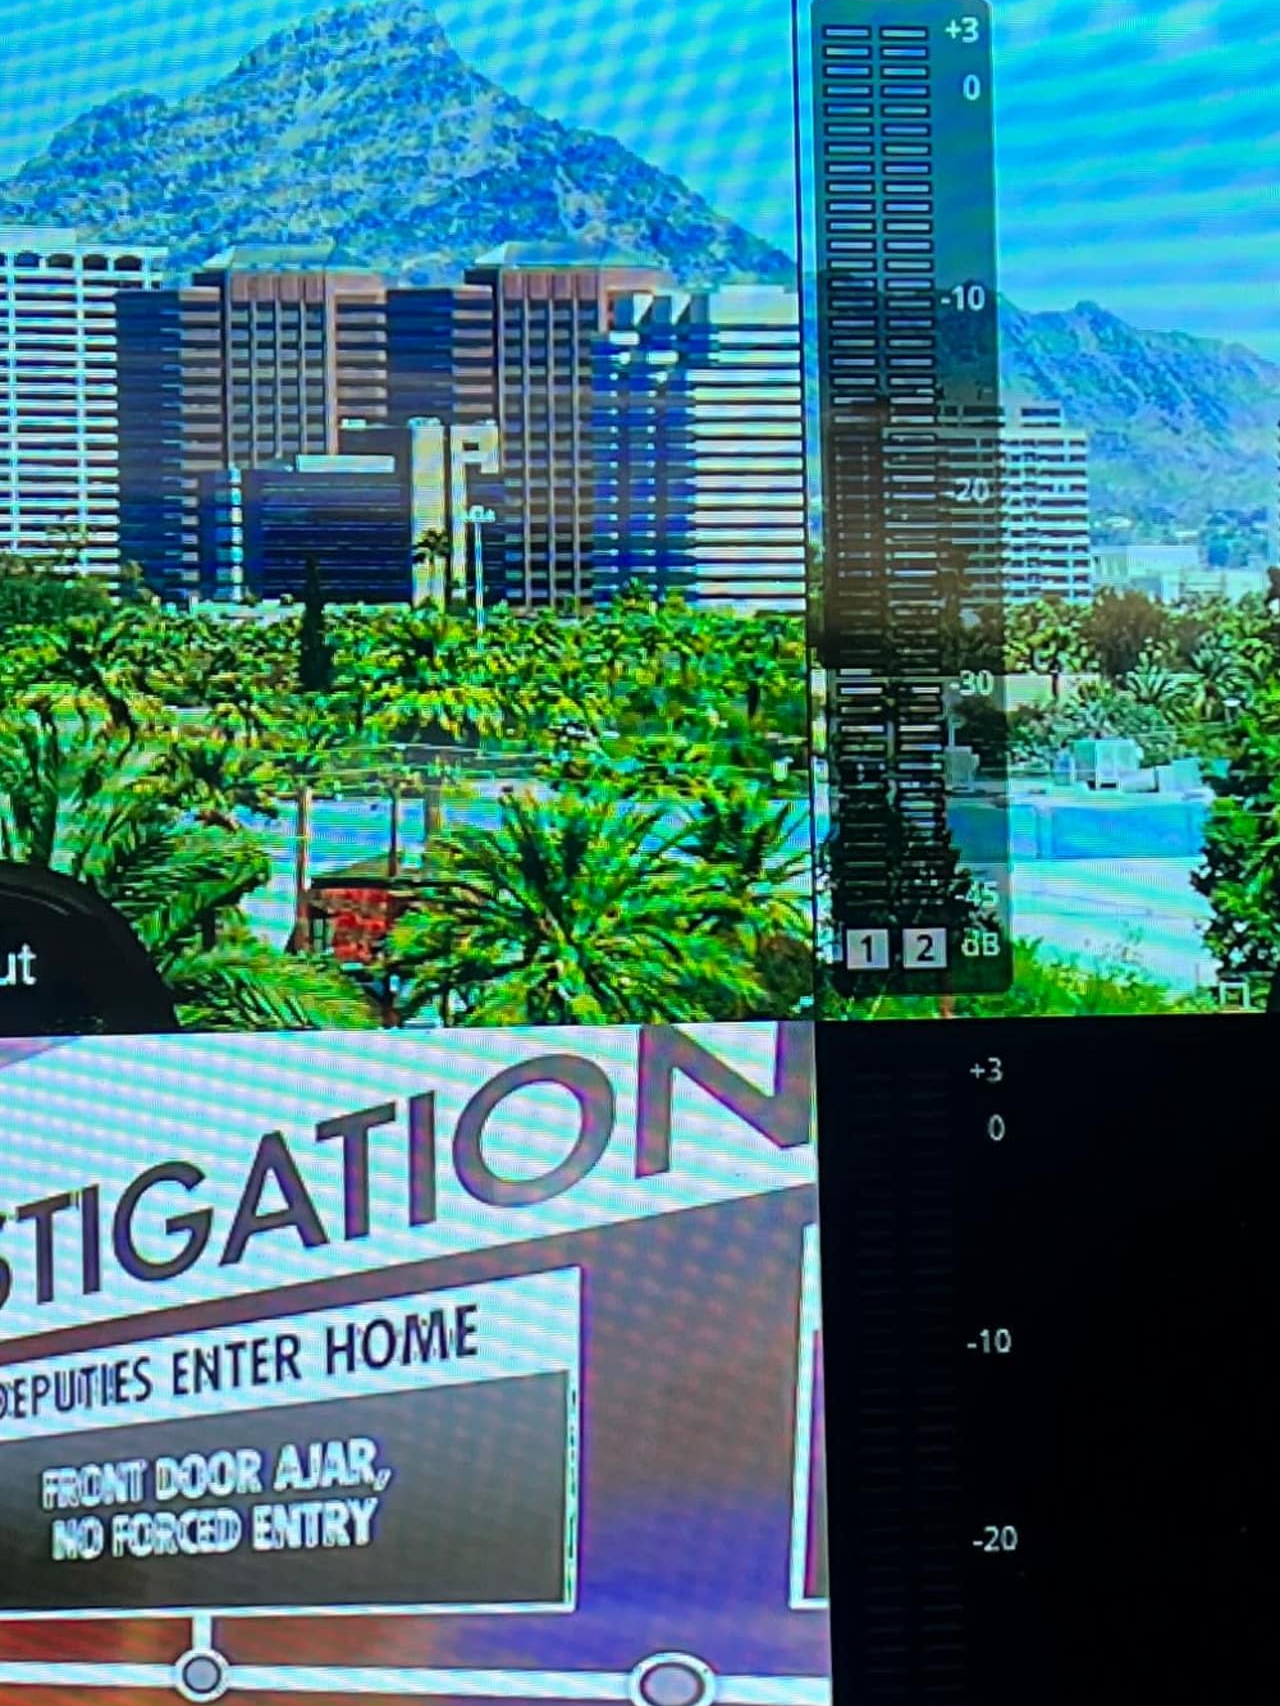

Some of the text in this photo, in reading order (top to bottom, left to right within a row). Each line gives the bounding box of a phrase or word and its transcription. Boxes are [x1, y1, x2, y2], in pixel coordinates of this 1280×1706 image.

[945, 17, 980, 43] +3
[962, 74, 981, 101] 0
[940, 285, 986, 310] -10
[949, 670, 994, 696] -30
[860, 930, 1000, 963] 1 2 dB
[969, 1056, 1004, 1083] +3
[987, 1114, 1006, 1141] 0
[172, 1332, 302, 1396] ENTER
[325, 1304, 480, 1377] HOME
[966, 1328, 1012, 1354] -10
[42, 1437, 392, 1510] FRONT DOOR AJAR,
[51, 1496, 379, 1561] NO FORCED ENTRY
[972, 1526, 1018, 1552] -20
